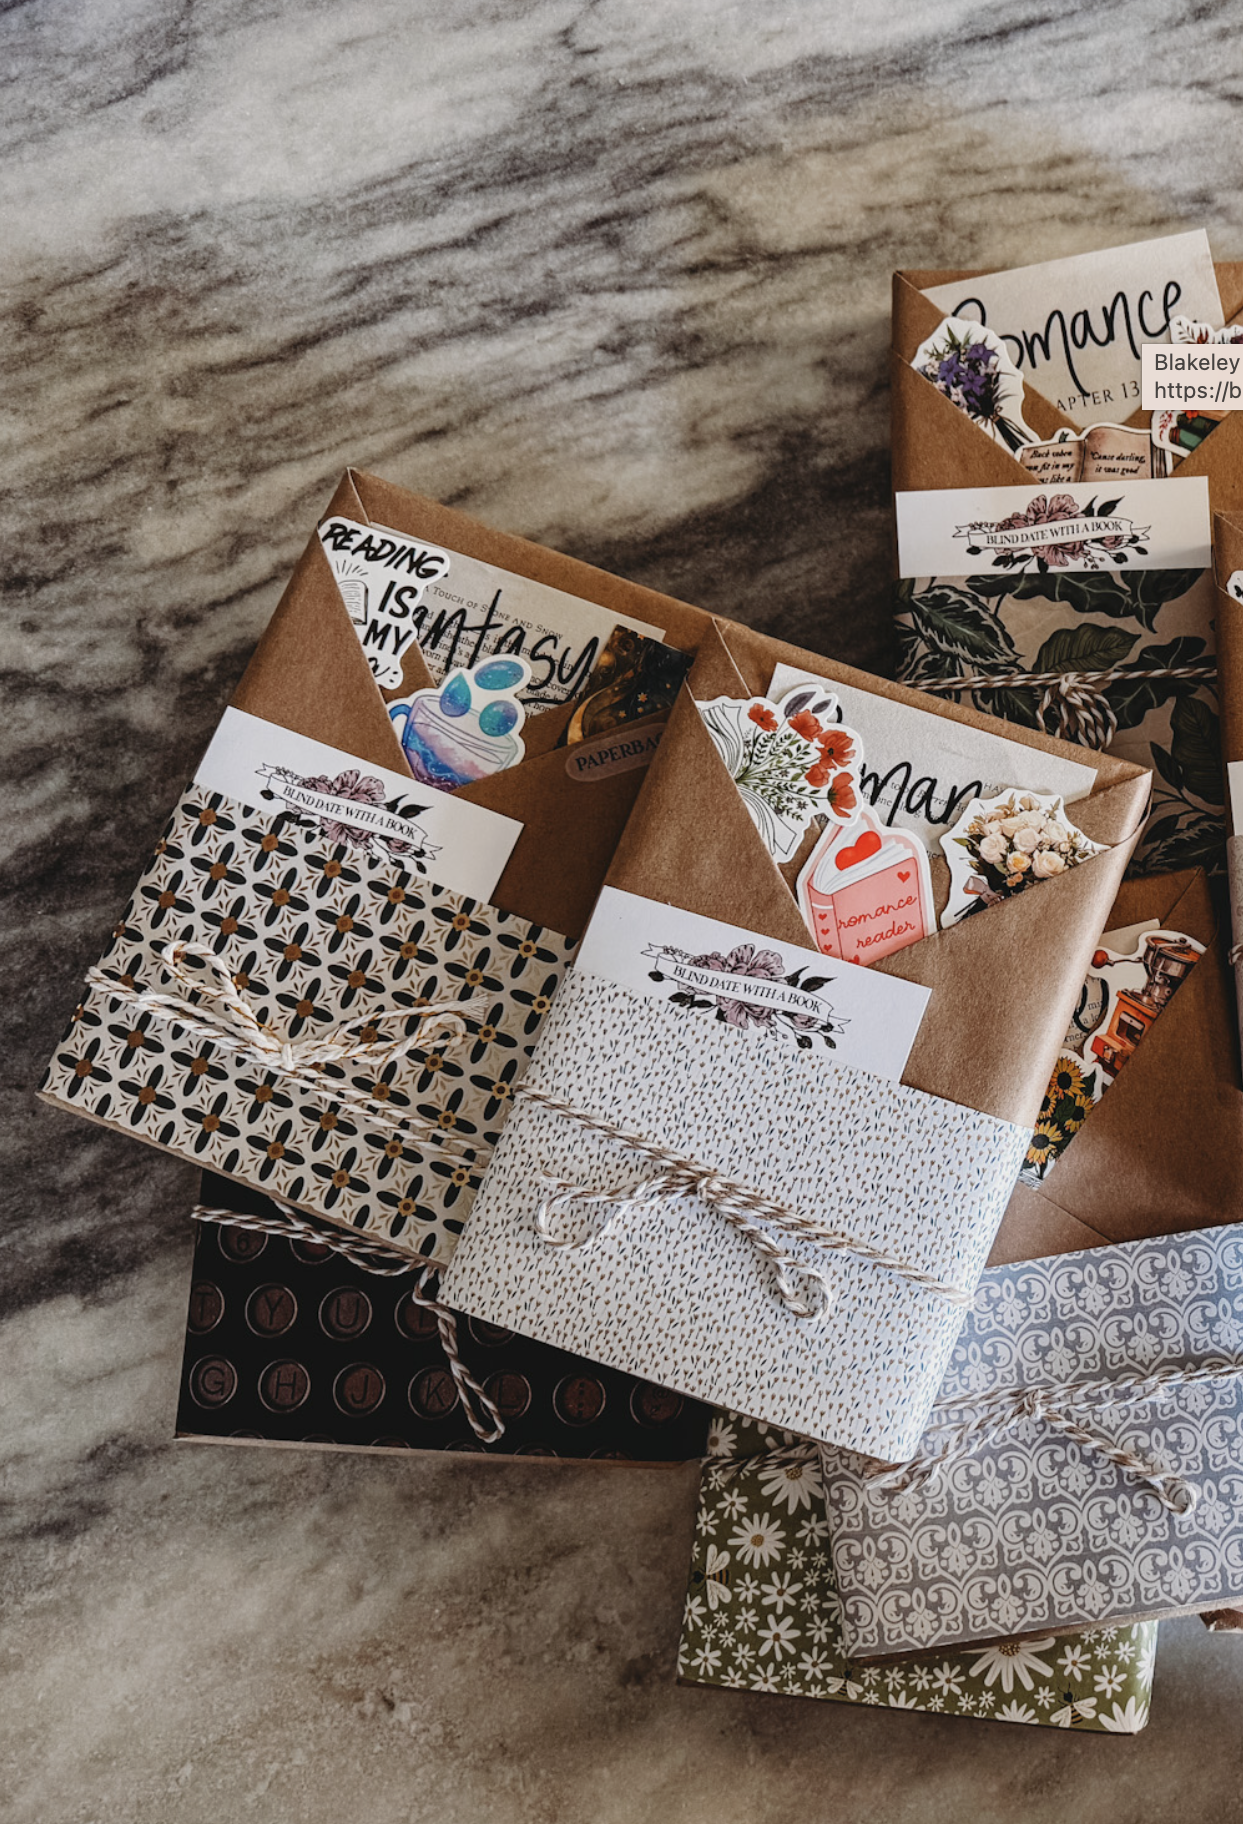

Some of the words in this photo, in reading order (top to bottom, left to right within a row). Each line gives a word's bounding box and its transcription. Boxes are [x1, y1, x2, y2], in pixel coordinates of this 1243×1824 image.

[952, 280, 1181, 396] omance
[1121, 380, 1140, 399] 13
[322, 522, 445, 579] READING
[986, 534, 1019, 545] BLIND
[1021, 529, 1048, 543] DATE
[1050, 524, 1080, 538] WITH
[1081, 523, 1090, 533] A
[1091, 520, 1123, 532] BOOK
[378, 580, 418, 619] IS
[433, 586, 465, 605] TOUCH
[466, 600, 478, 609] OF
[480, 603, 511, 620] SONE
[512, 618, 533, 630] AND
[535, 624, 563, 640] SNOW
[362, 619, 413, 656] MY
[413, 588, 599, 704] antasy
[283, 786, 315, 806] BLIND
[315, 798, 345, 815] DATE
[345, 806, 376, 824] WITH
[375, 815, 385, 826] A
[385, 818, 418, 840] BOOK
[837, 895, 917, 930] romance
[856, 920, 916, 949] reader
[673, 965, 708, 985] BLIND
[709, 977, 741, 993] DATE
[743, 983, 776, 999] WITH
[777, 991, 786, 1002] A
[787, 993, 823, 1014] BOOK
[262, 1295, 286, 1325] Y
[336, 1298, 360, 1330] U
[202, 1366, 225, 1396] G
[276, 1370, 297, 1401] H
[350, 1373, 371, 1404] J
[426, 1376, 446, 1407] K
